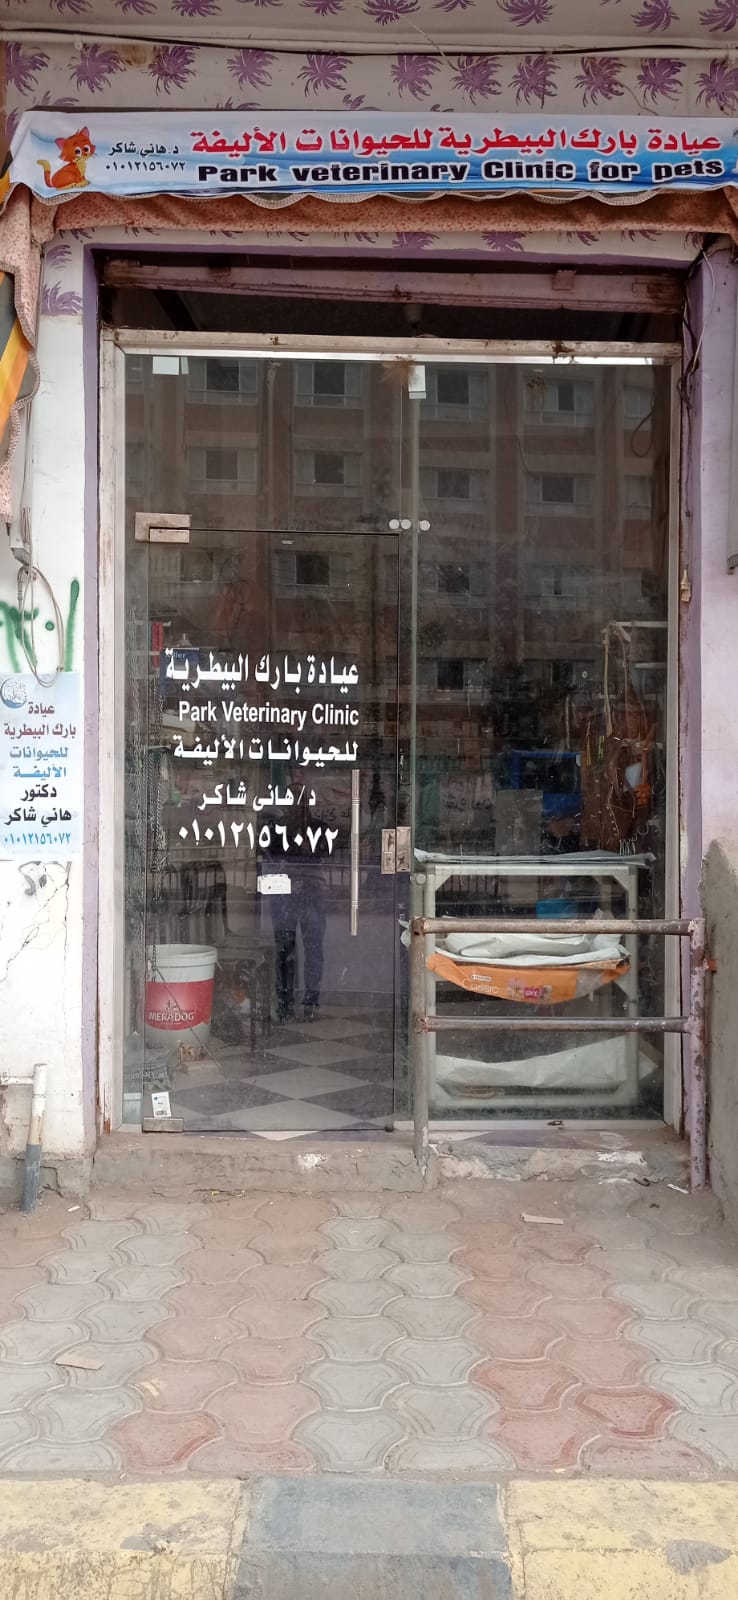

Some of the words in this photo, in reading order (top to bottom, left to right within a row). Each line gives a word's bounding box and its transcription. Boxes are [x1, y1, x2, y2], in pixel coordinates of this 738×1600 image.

[108, 141, 136, 156] شاكر
[190, 126, 286, 156] الأليفة
[439, 126, 566, 156] البيطرية
[571, 127, 637, 156] بارك
[648, 129, 721, 155] عيادة
[198, 165, 279, 183] Park
[292, 162, 468, 183] veterinary
[484, 161, 575, 180] Clinic
[590, 161, 640, 180] for
[655, 158, 724, 181] pets
[165, 648, 249, 691] البيطرية
[255, 653, 301, 694] بارك
[307, 654, 359, 694] عيادة
[28, 701, 55, 718] عيادة
[179, 701, 217, 722] Park
[221, 702, 307, 731] Veterinary
[312, 704, 359, 725] Clinic
[4, 723, 49, 740] البيطرية
[52, 723, 76, 739] بارك
[10, 746, 68, 761] للحيوانات
[173, 734, 244, 766] الأليفة
[249, 738, 358, 768] للحيوانات
[20, 784, 57, 802] دكتور
[198, 781, 247, 811] شاكر
[4, 805, 37, 826] شاكر
[41, 807, 72, 828] هاني
[178, 819, 339, 855] ٠١٠١٢١٥٦٠٧٢
